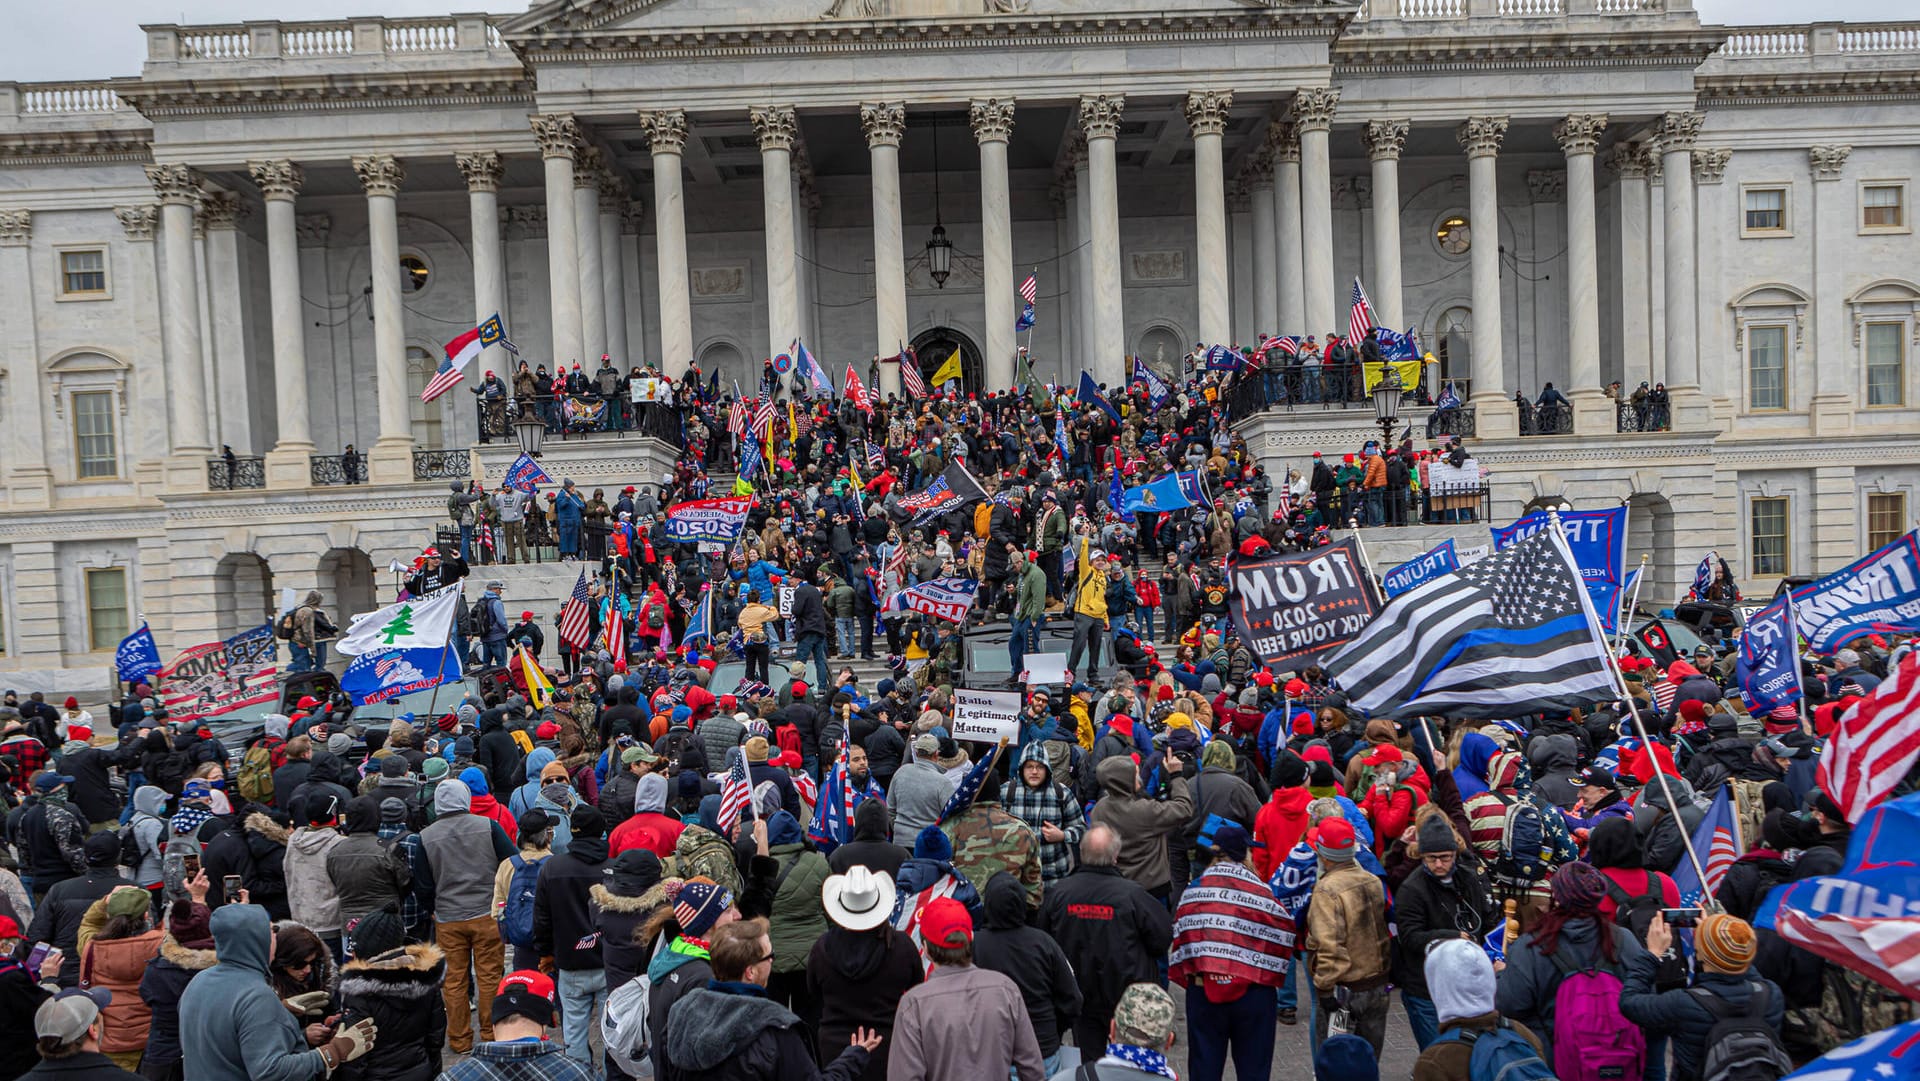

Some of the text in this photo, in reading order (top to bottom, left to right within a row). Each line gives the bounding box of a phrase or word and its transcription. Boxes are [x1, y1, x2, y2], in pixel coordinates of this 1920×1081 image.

[906, 593, 965, 621] TRUM
[958, 695, 993, 706] Ballot
[957, 707, 1018, 723] Legitimacy
[954, 721, 998, 734] Matters
[1215, 917, 1226, 926] to
